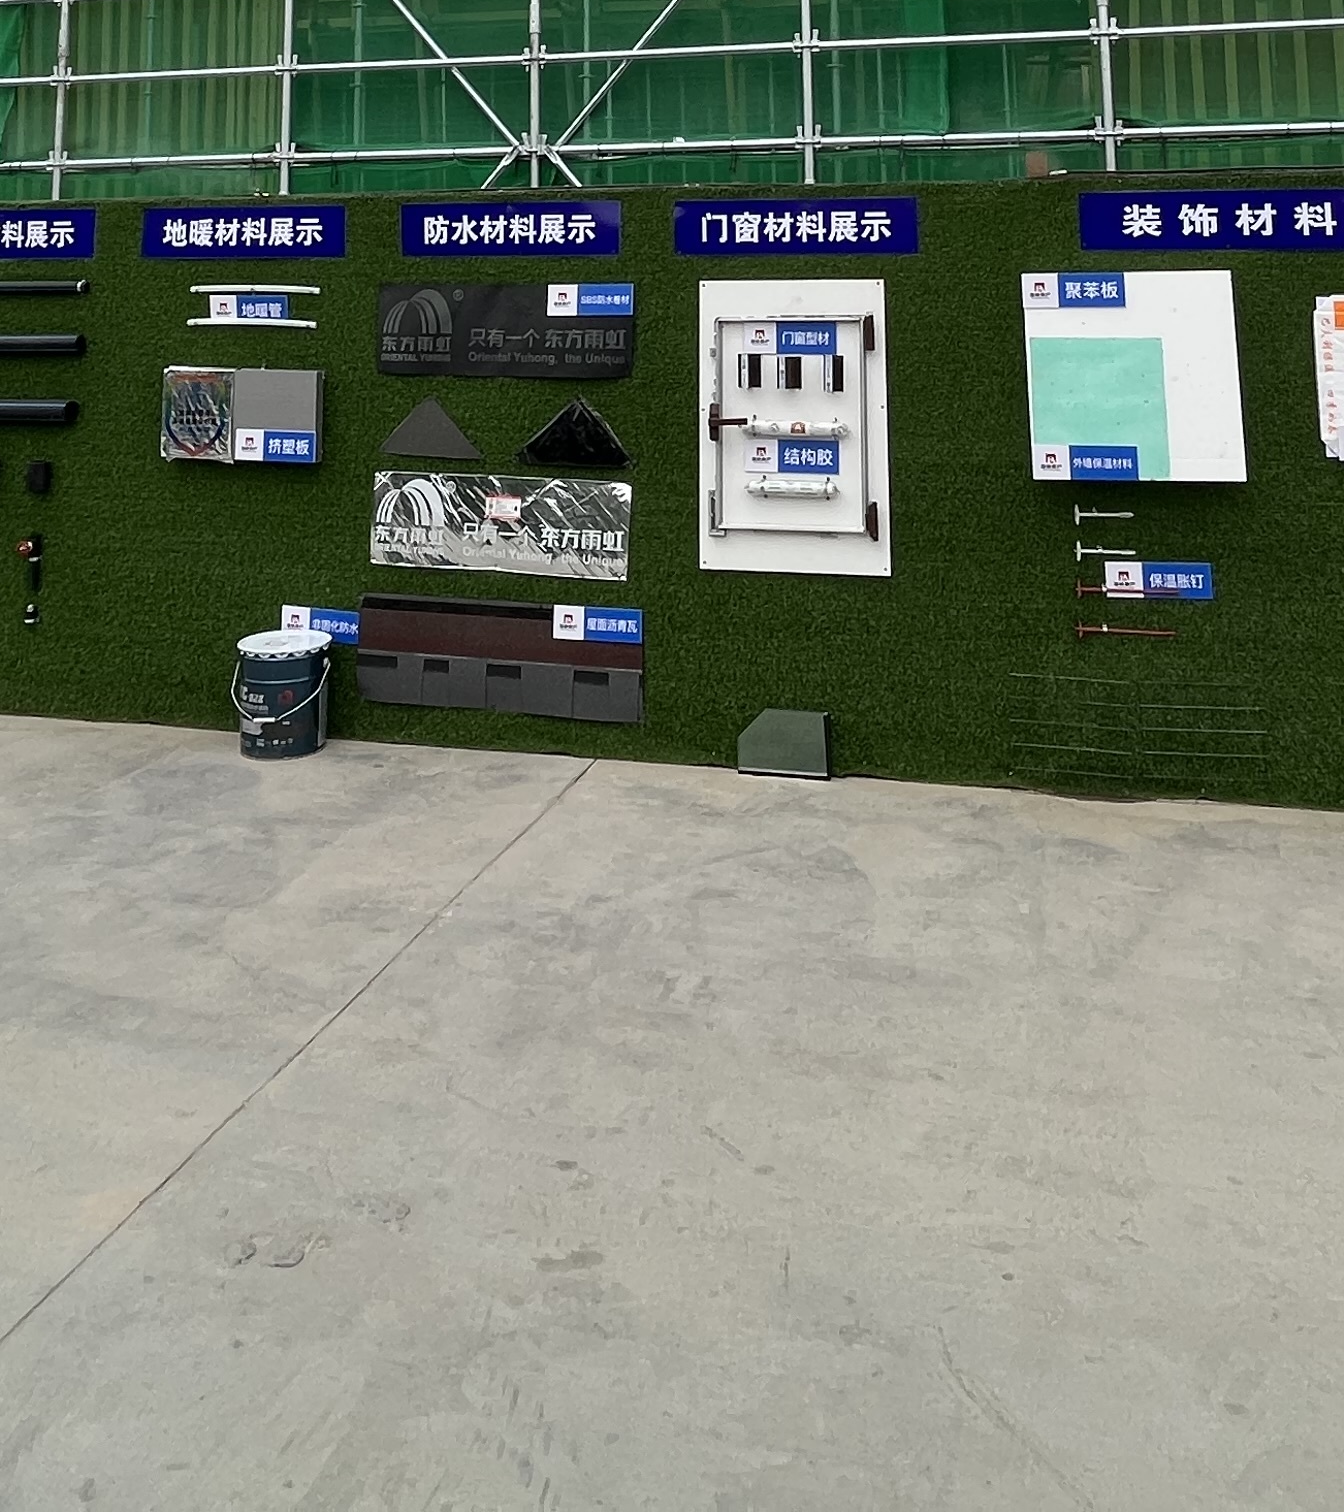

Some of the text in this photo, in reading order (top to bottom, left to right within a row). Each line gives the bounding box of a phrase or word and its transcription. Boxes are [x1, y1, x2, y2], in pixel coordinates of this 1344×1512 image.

[162, 218, 324, 248] 地暖材料展示
[423, 213, 597, 245] 防水材料展示
[700, 211, 892, 244] 门窗材料展示
[1064, 281, 1119, 299] 聚苯板
[579, 294, 631, 306] SBS防水卷材
[241, 302, 282, 318] 地暖管
[381, 336, 452, 352] 东方雨虹
[468, 328, 627, 351] 只有一个 东方雨虹
[782, 331, 830, 346] 门窗型材
[468, 351, 511, 363] Oriental
[564, 353, 582, 364] the
[585, 353, 625, 366] Unique
[267, 438, 310, 456] 挤塑板
[783, 447, 834, 467] 结构胶
[1072, 457, 1133, 470] 外墙保温材料
[374, 525, 444, 545] 东方雨虹
[462, 522, 626, 553] 只有一个 东方雨虹
[1149, 572, 1205, 589] 保温胀钉
[586, 617, 638, 634] 屋面沥青瓦
